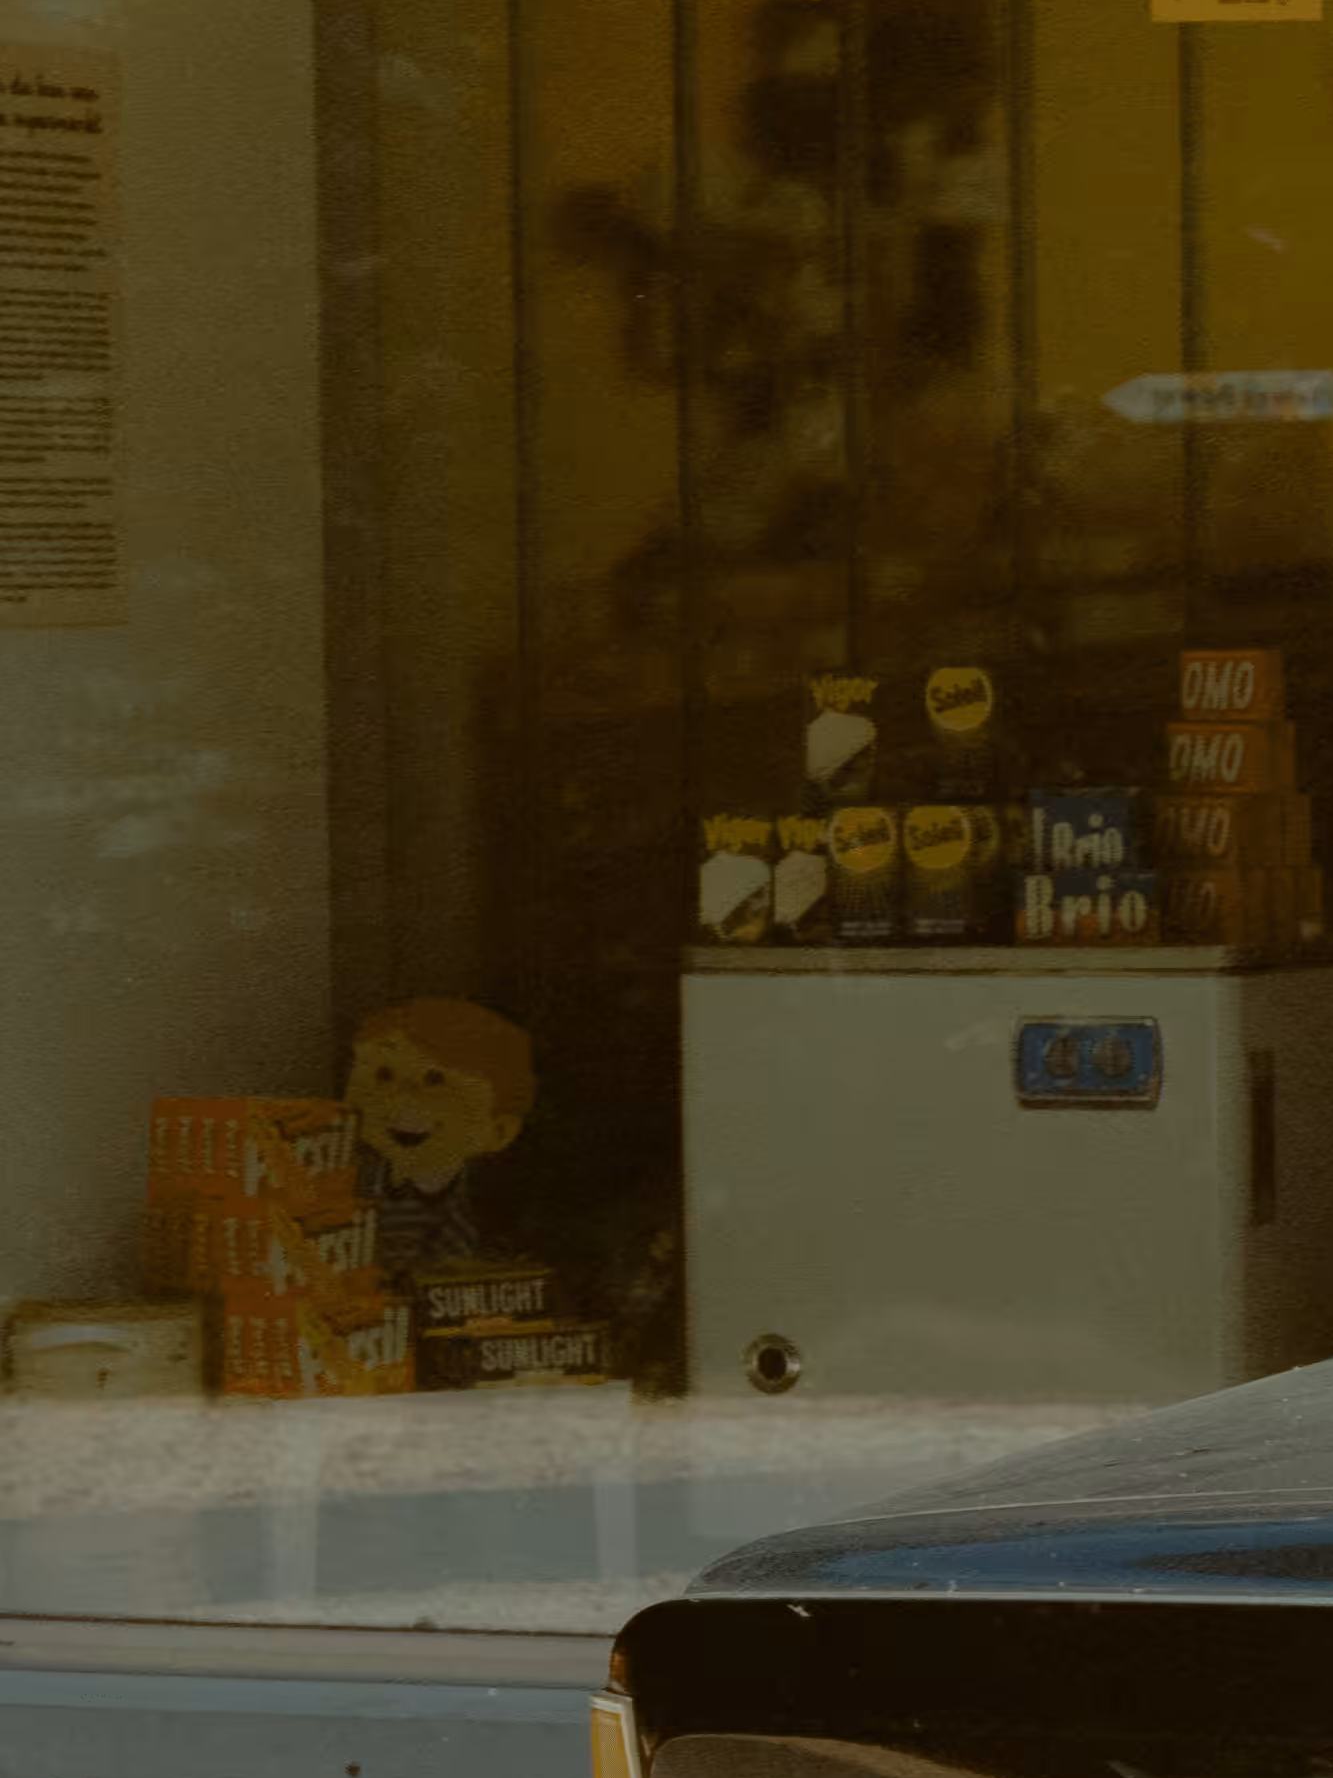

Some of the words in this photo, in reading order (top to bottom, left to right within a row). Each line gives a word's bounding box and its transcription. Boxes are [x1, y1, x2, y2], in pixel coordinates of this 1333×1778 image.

[1181, 660, 1255, 711] OMO
[1168, 733, 1245, 784] OMO
[1023, 874, 1148, 940] Brio
[427, 1277, 546, 1320] SUNLIGHT
[479, 1332, 597, 1373] SUNLIGHT
